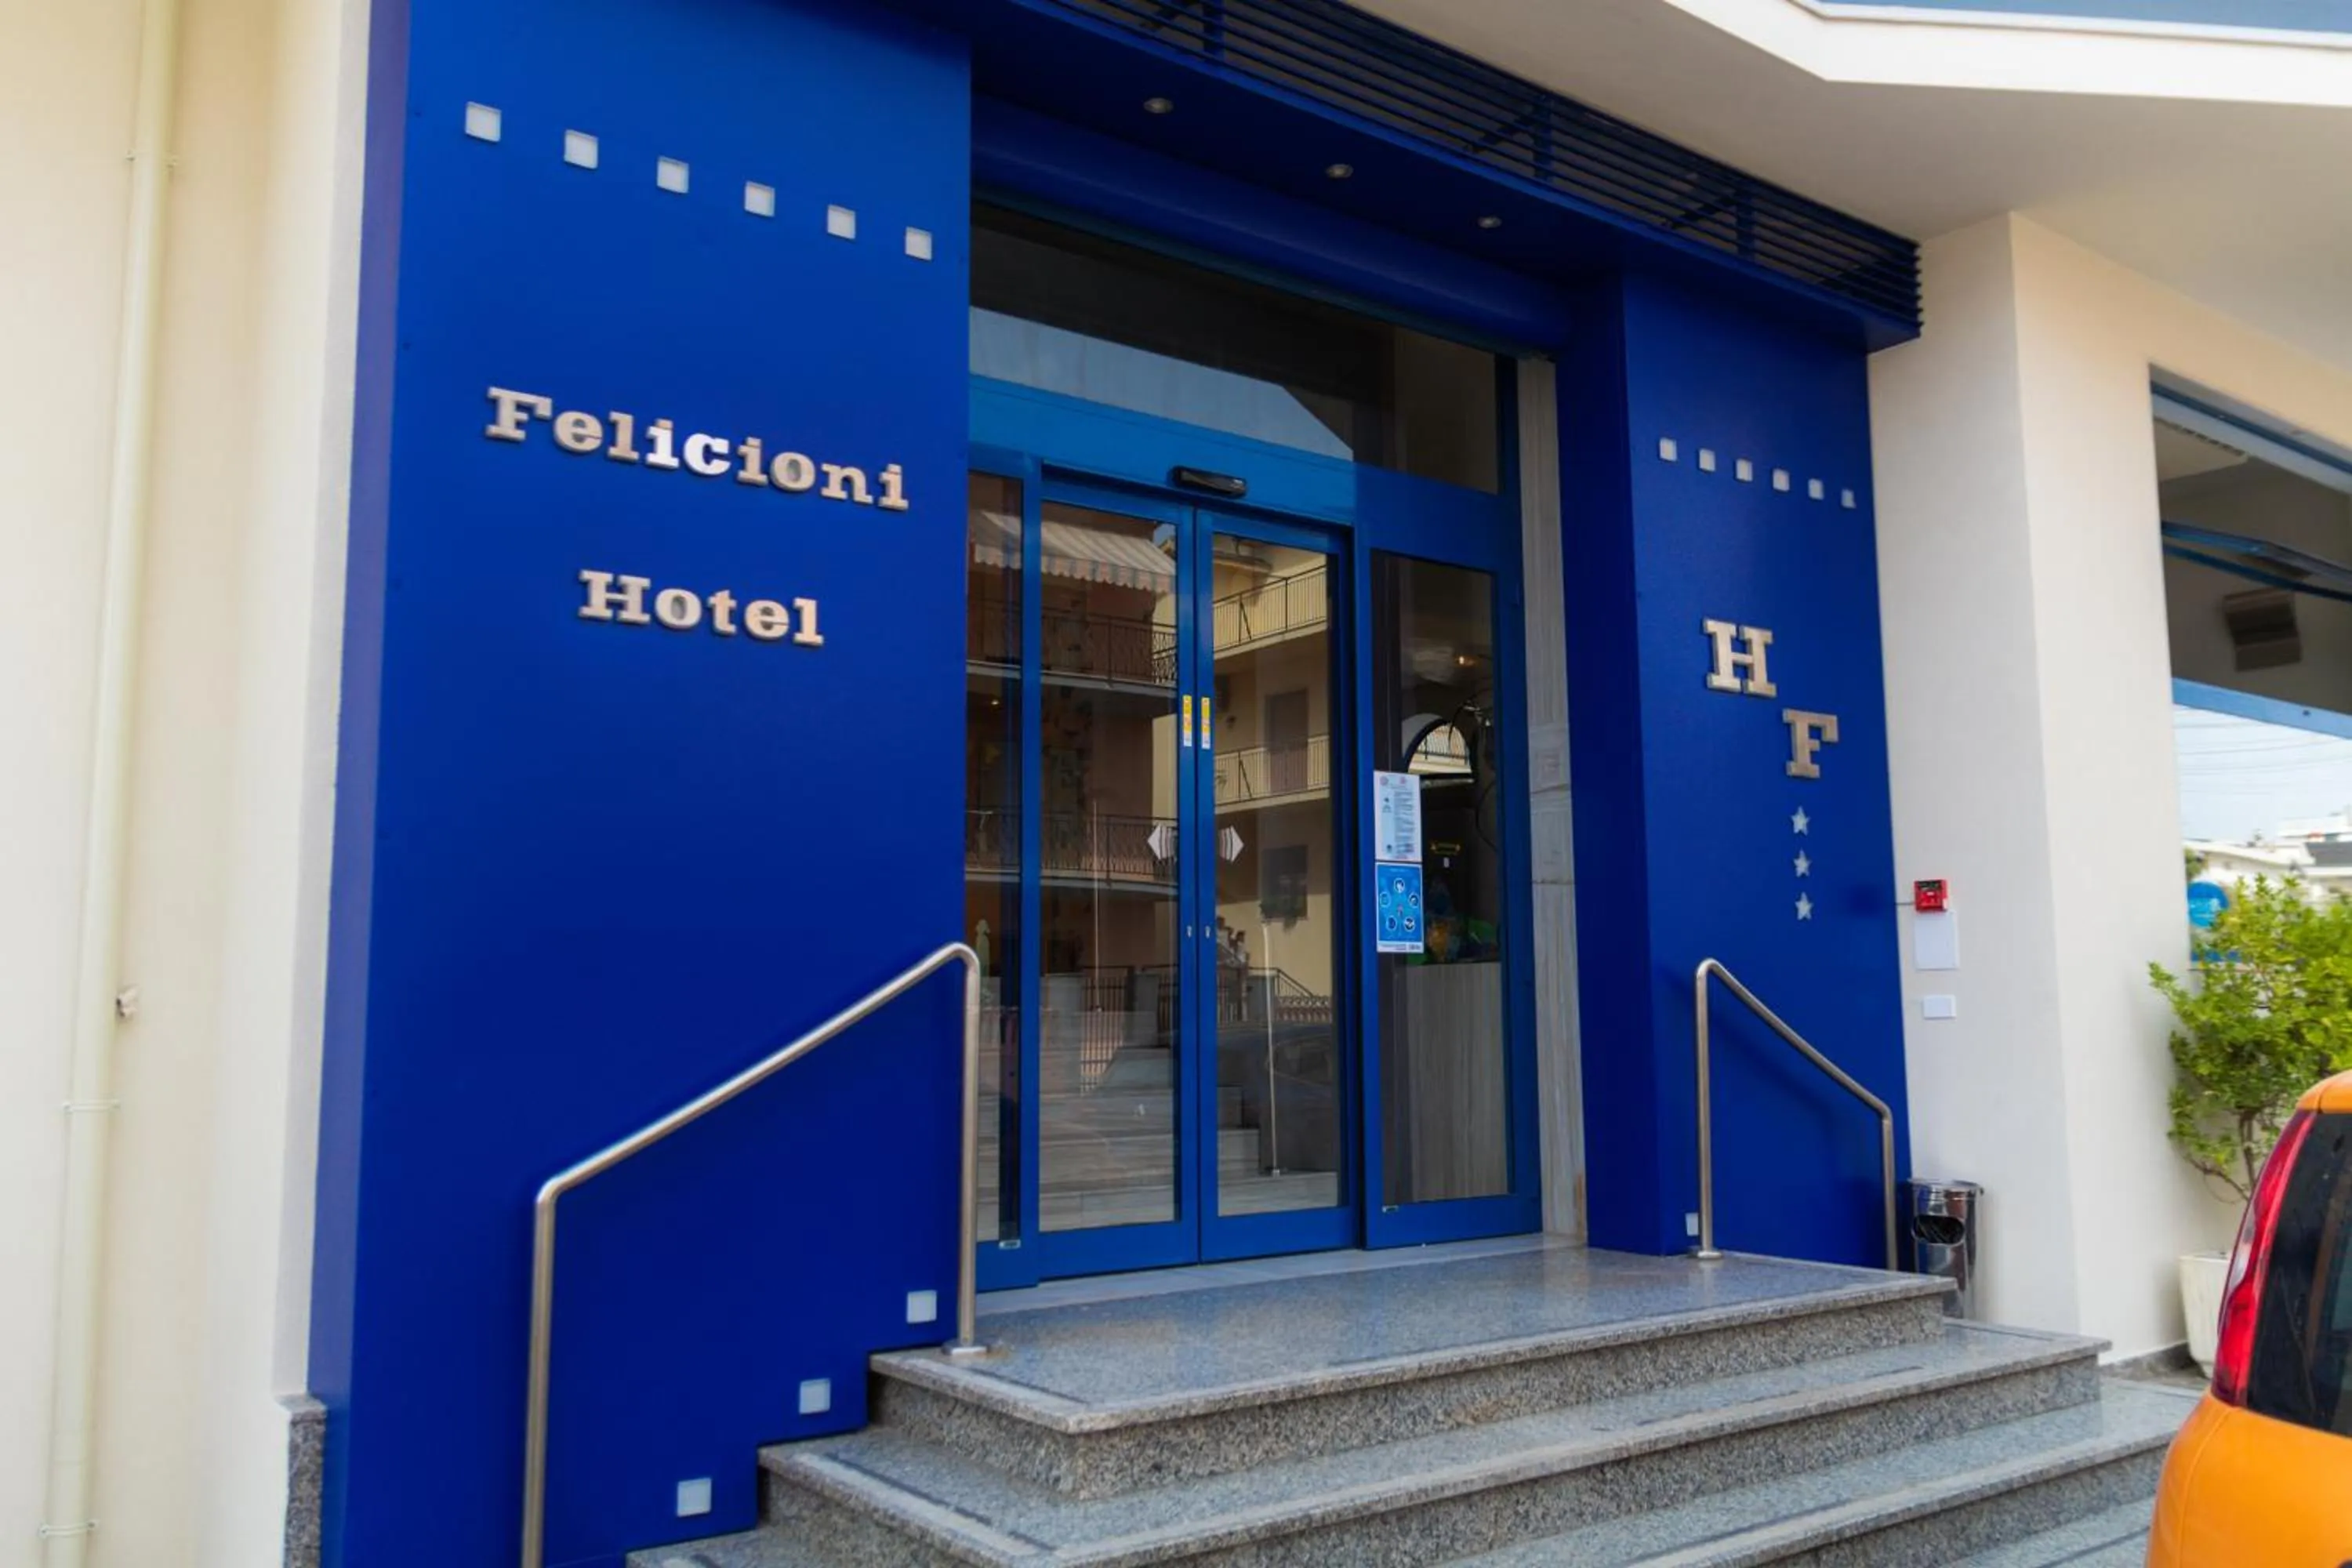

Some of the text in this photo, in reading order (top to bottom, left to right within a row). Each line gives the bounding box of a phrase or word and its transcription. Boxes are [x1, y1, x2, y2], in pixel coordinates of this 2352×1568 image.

[485, 387, 909, 510] Felicioni
[579, 570, 823, 646] Hotel
[1703, 617, 1777, 698] H
[1783, 708, 1838, 778] F
